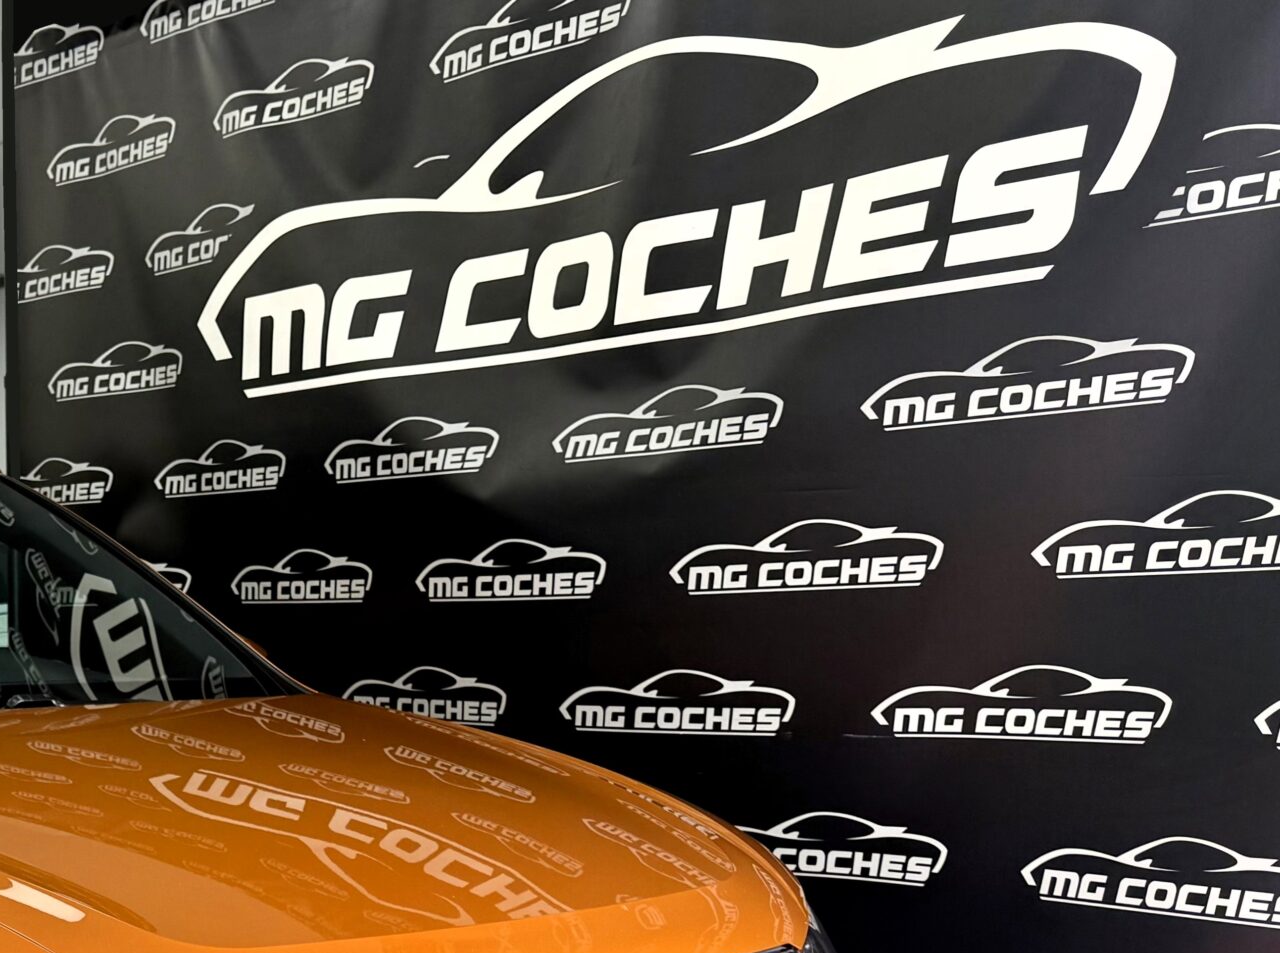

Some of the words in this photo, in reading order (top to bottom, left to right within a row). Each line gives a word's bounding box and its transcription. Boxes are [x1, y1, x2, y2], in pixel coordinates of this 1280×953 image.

[150, 11, 182, 40] MG
[443, 44, 482, 78] MG
[489, 3, 621, 62] COCHES
[21, 40, 99, 83] COCHES
[222, 106, 257, 134] MG
[262, 77, 364, 123] COCHES
[56, 158, 90, 182] MG
[95, 136, 168, 173] COCHES
[154, 246, 183, 271] MG
[242, 270, 412, 380] MG
[435, 125, 1088, 352] COCHES
[25, 266, 106, 298] COCHES
[56, 377, 89, 398] MG
[94, 364, 177, 393] COCHES
[883, 393, 956, 425] MG
[968, 368, 1175, 417] COCHES
[565, 431, 620, 458] MG
[625, 414, 768, 452] COCHES
[336, 457, 370, 479] MG
[377, 446, 487, 475] COCHES
[165, 474, 196, 494] MG
[202, 466, 278, 491] COCHES
[1056, 543, 1135, 573] MG
[1146, 535, 1280, 569] COCH
[241, 581, 271, 600] MG
[277, 579, 364, 599] COCHES
[429, 576, 468, 597] MG
[476, 572, 594, 596] COCHES
[688, 564, 748, 590] MG
[758, 555, 927, 587] COCHES
[397, 698, 497, 722] COCHES
[575, 705, 625, 727] MG
[634, 707, 781, 731] COCHES
[893, 708, 964, 733] MG
[975, 708, 1154, 738] COCHES
[773, 847, 933, 881] COCHES
[1040, 869, 1107, 901] MG
[1116, 878, 1280, 922] COCHE
